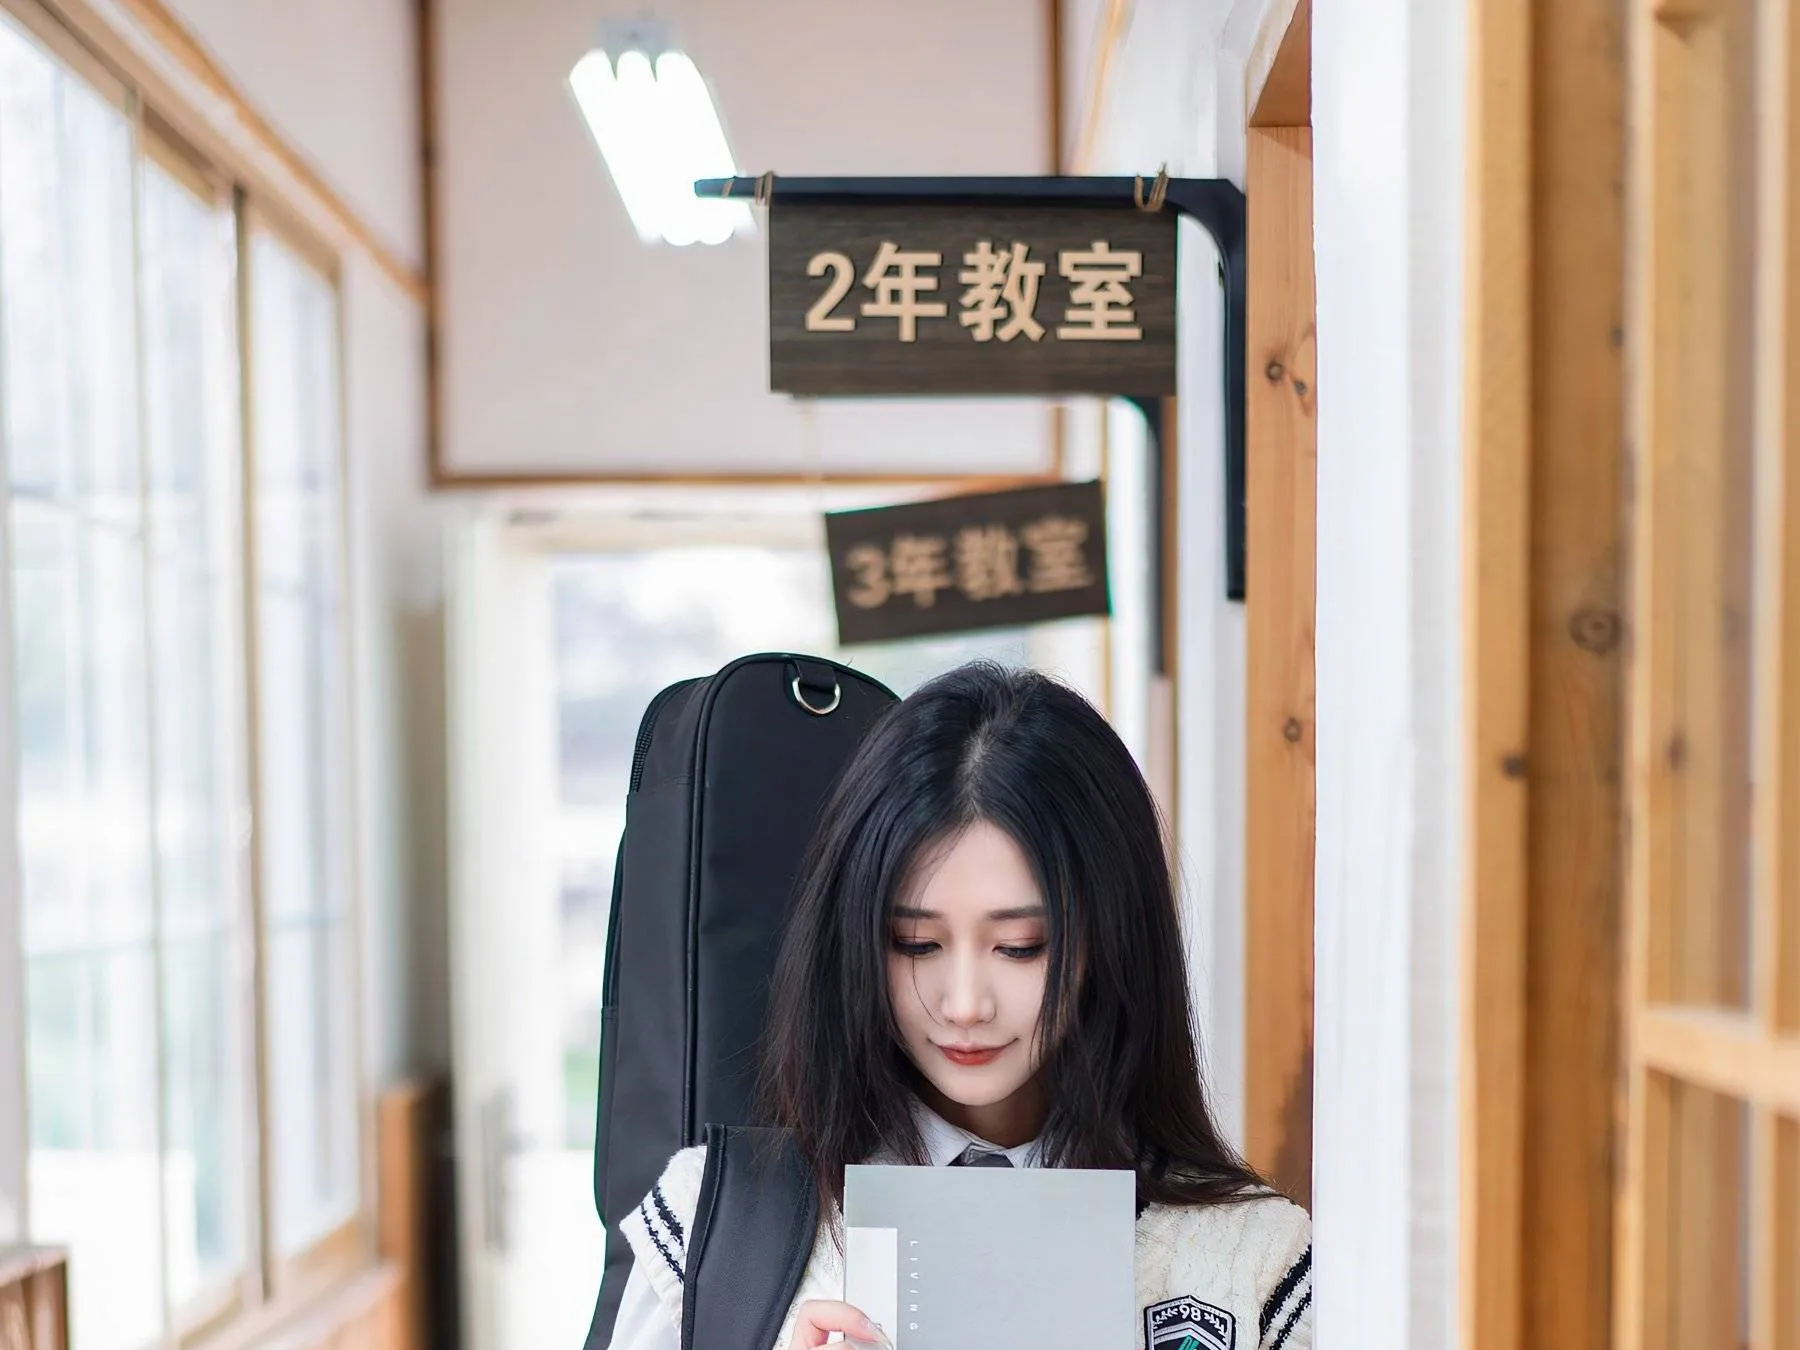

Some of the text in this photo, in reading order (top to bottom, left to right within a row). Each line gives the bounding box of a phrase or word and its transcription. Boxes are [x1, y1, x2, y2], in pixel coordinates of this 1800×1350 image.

[805, 241, 1144, 343] 2年教室
[845, 515, 1095, 608] 3年教室
[909, 1240, 919, 1331] LIVING
[1178, 1304, 1202, 1322] 98
